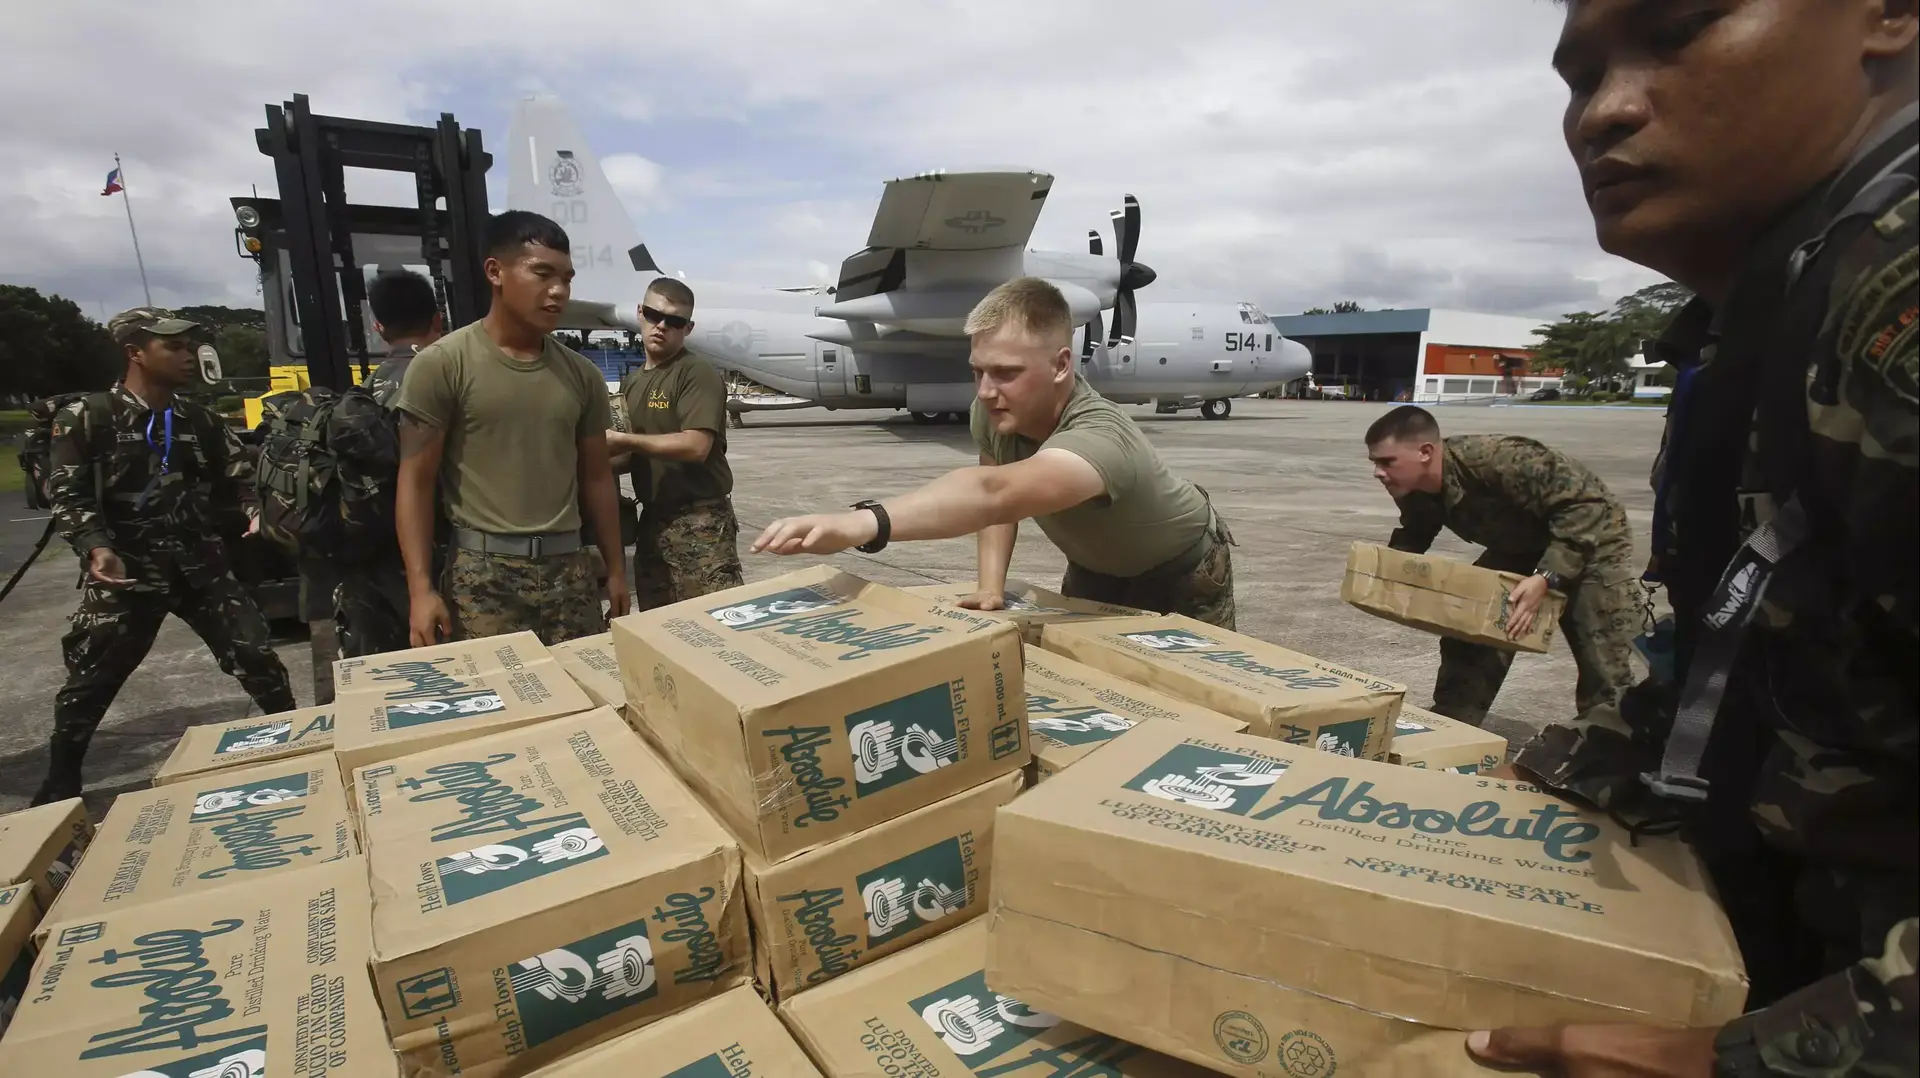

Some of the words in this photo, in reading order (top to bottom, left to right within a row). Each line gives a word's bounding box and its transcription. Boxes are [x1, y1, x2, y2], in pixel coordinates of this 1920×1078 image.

[1225, 332, 1255, 352] 514
[928, 605, 937, 613] 3
[943, 609, 967, 622] 6000
[735, 608, 943, 661] Absolute
[992, 651, 1000, 660] 3
[992, 661, 1000, 671] x
[1162, 650, 1340, 690] Absolute
[951, 676, 969, 716] Help
[994, 672, 1005, 701] 6000
[573, 730, 596, 749] SALE
[957, 716, 972, 760] Flows
[1183, 737, 1236, 755] Help
[1234, 746, 1294, 765] Flows
[602, 778, 627, 805] GROUP
[762, 725, 852, 828] Absolute
[1476, 780, 1489, 788] 3
[1495, 782, 1509, 791] x
[396, 752, 583, 843] Absolute
[1098, 799, 1180, 823] LUCIO
[1181, 817, 1233, 835] TAN
[1232, 831, 1327, 852] GROUP
[1111, 808, 1146, 820] OF
[1147, 817, 1296, 854] COMPANIES
[1138, 803, 1222, 827] DONATED
[1224, 821, 1253, 832] BY
[1252, 828, 1293, 841] THE
[1249, 777, 1600, 863] Absolute
[124, 849, 143, 865] NOT
[189, 805, 322, 880] Absolute
[959, 830, 974, 868] Help
[1297, 818, 1387, 843] Distilled
[1396, 838, 1504, 866] Drinking
[1515, 858, 1597, 878] Water
[1411, 832, 1468, 848] Pure
[103, 879, 125, 902] SALE
[115, 863, 135, 881] FOR
[965, 868, 979, 906] Flows
[1343, 856, 1413, 878] NOT
[1423, 873, 1497, 896] FOR
[1505, 889, 1605, 915] SALE
[1366, 856, 1582, 900] COMPLIMENTARY
[319, 887, 336, 916] SALE
[254, 908, 271, 934] Water
[307, 898, 320, 964] COMPLIMENTARY
[319, 917, 336, 943] FOR
[775, 887, 862, 983] Absolute
[56, 947, 74, 962] mL
[224, 953, 244, 980] Pure
[248, 932, 272, 979] Drinking
[319, 943, 336, 966] NOT
[41, 963, 67, 986] 6000
[41, 985, 56, 994] x
[78, 918, 268, 1061] Absolute
[32, 995, 51, 1004] 3
[243, 979, 265, 1018] Distilled
[297, 993, 309, 1014] THE
[311, 973, 327, 1014] GROUP
[328, 976, 347, 1048] COMPANIES
[492, 967, 515, 1023] Flows
[297, 1014, 309, 1027] BY
[310, 1014, 327, 1044] TAN
[500, 1020, 528, 1057] Help
[864, 1016, 907, 1060] LUCIO
[294, 1027, 309, 1076] DONATED
[308, 1044, 327, 1078] UCIO
[329, 1050, 347, 1068] OF
[720, 1041, 753, 1078] Help
[860, 1034, 884, 1052] OF
[893, 1030, 940, 1078] DONATED
